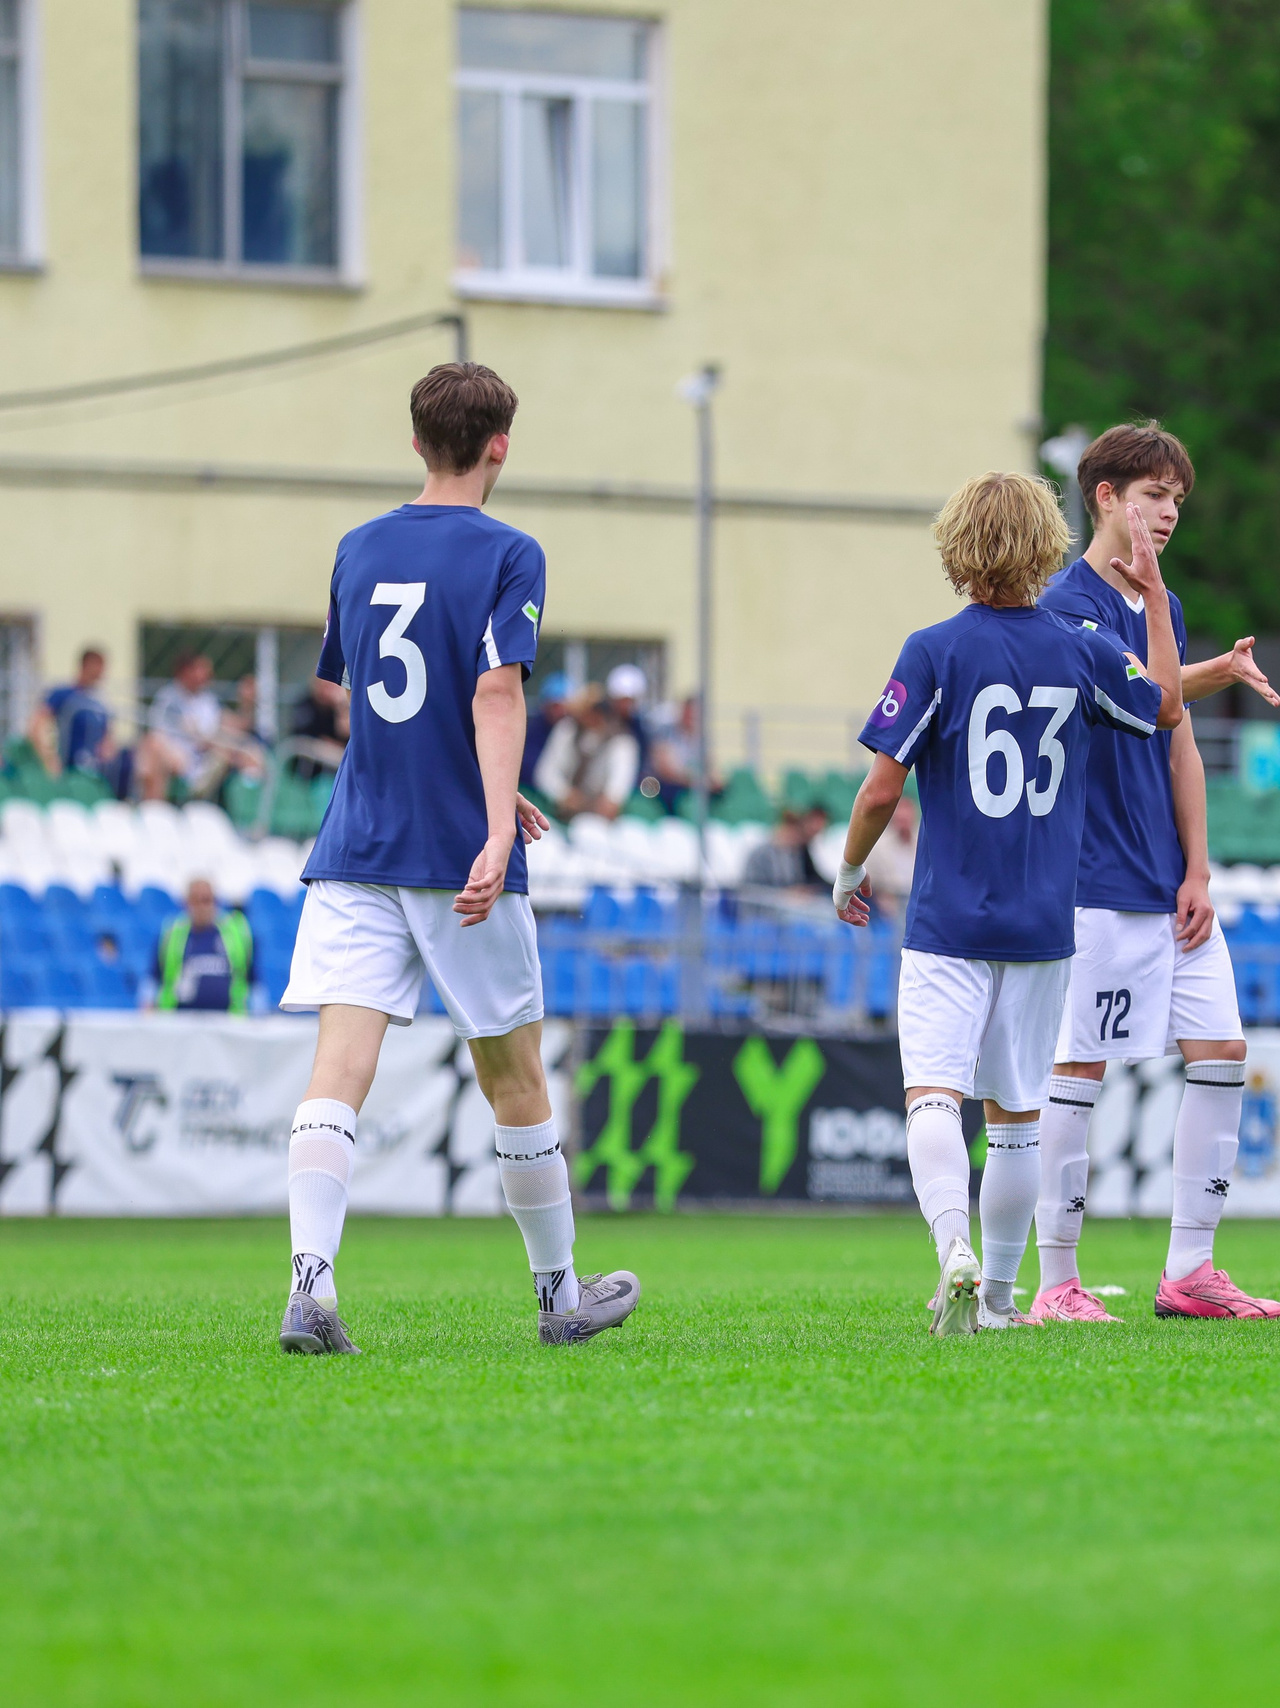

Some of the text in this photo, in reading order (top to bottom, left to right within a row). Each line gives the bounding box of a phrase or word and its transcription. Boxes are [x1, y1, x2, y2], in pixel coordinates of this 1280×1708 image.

[366, 582, 428, 724] 3
[967, 683, 1078, 818] 63
[1095, 988, 1132, 1042] 72
[292, 1123, 342, 1136] KELME
[503, 1147, 555, 1161] KELME
